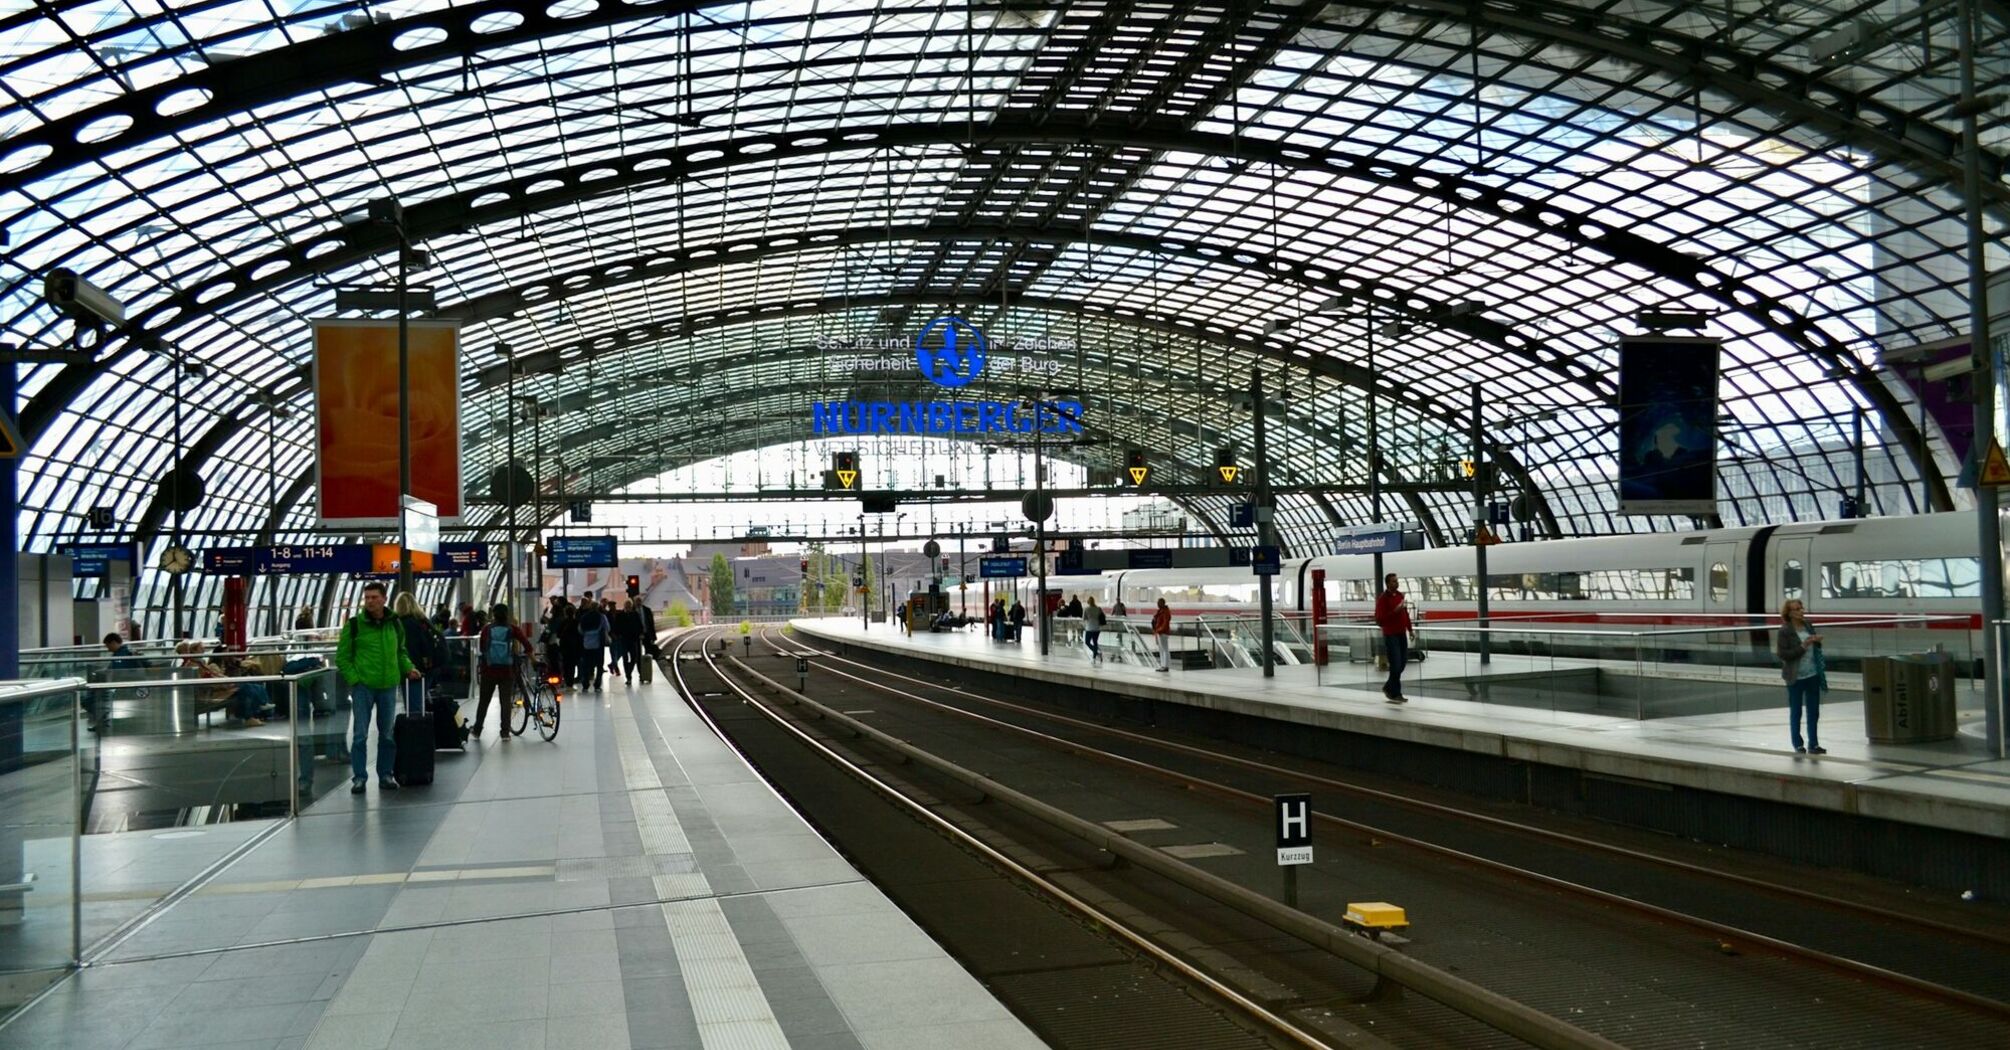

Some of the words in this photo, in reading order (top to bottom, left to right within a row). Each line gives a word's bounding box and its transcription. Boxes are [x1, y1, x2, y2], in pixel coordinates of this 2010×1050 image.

[816, 334, 873, 350] Sctz
[879, 335, 910, 349] und
[1013, 336, 1077, 351] Zeichen
[828, 354, 911, 371] Sicherheit
[989, 357, 1015, 371] der
[1021, 356, 1060, 376] Burg
[93, 508, 113, 524] 16
[573, 502, 591, 518] 15
[1232, 504, 1244, 523] F
[1497, 503, 1507, 520] F
[271, 547, 291, 559] 1-8
[303, 547, 334, 558] 11-14
[799, 660, 807, 671] H
[1896, 683, 1909, 728] Abfall
[1282, 801, 1307, 839] H
[1280, 852, 1310, 861] Kurzzug
